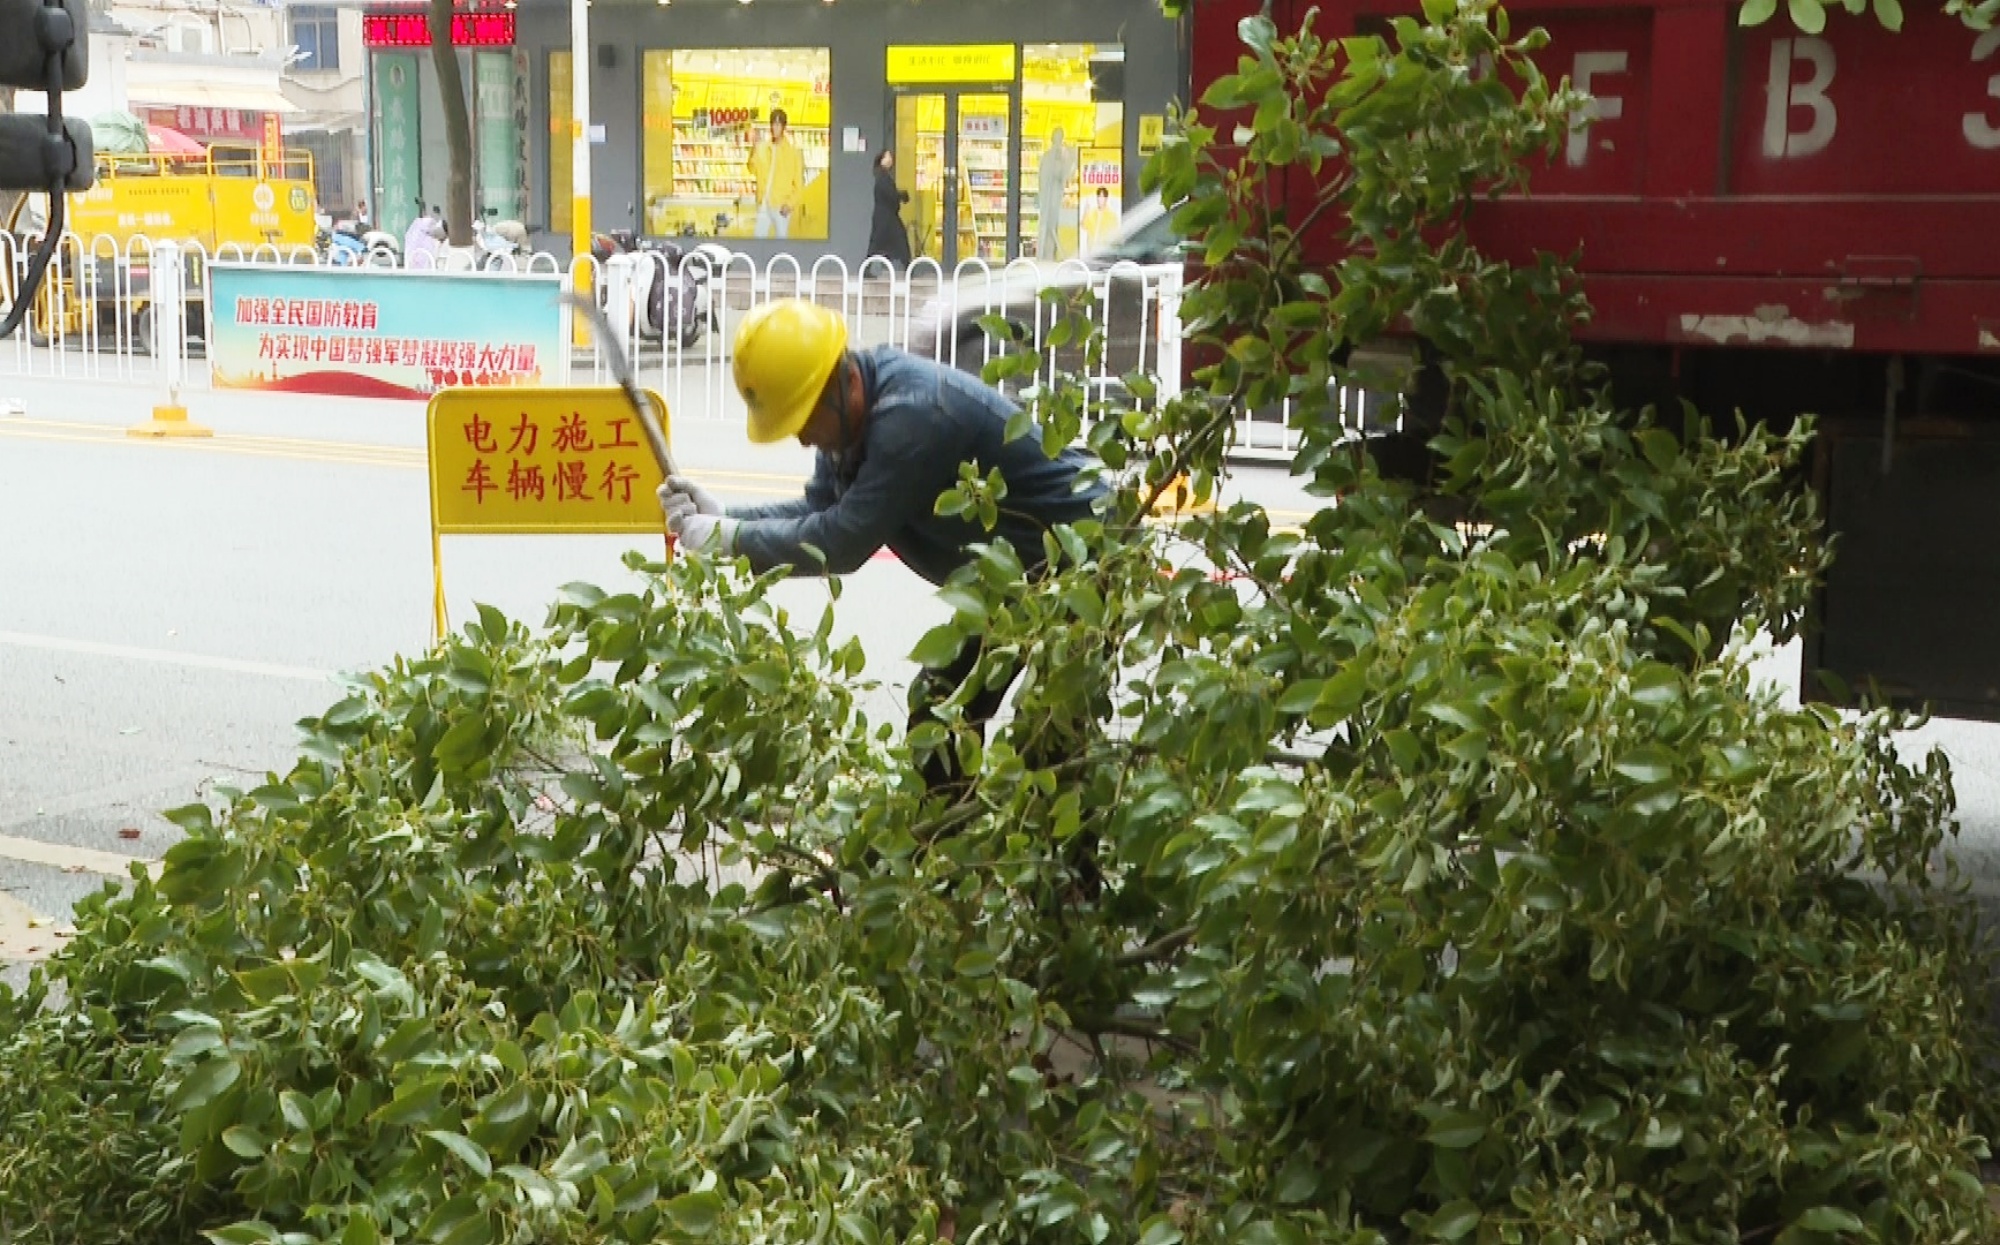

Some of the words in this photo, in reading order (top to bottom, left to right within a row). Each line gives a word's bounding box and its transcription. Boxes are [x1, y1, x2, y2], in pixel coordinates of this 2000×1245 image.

[709, 107, 749, 126] 10000
[1567, 51, 1628, 167] F
[1763, 37, 1837, 158] B
[1083, 173, 1119, 184] 10000
[236, 297, 378, 329] 加强全民国防教育
[259, 333, 537, 371] 为实现中国梦强军梦凝聚强大力量
[463, 411, 639, 456] 电力施工
[461, 459, 641, 504] 车辆慢行
